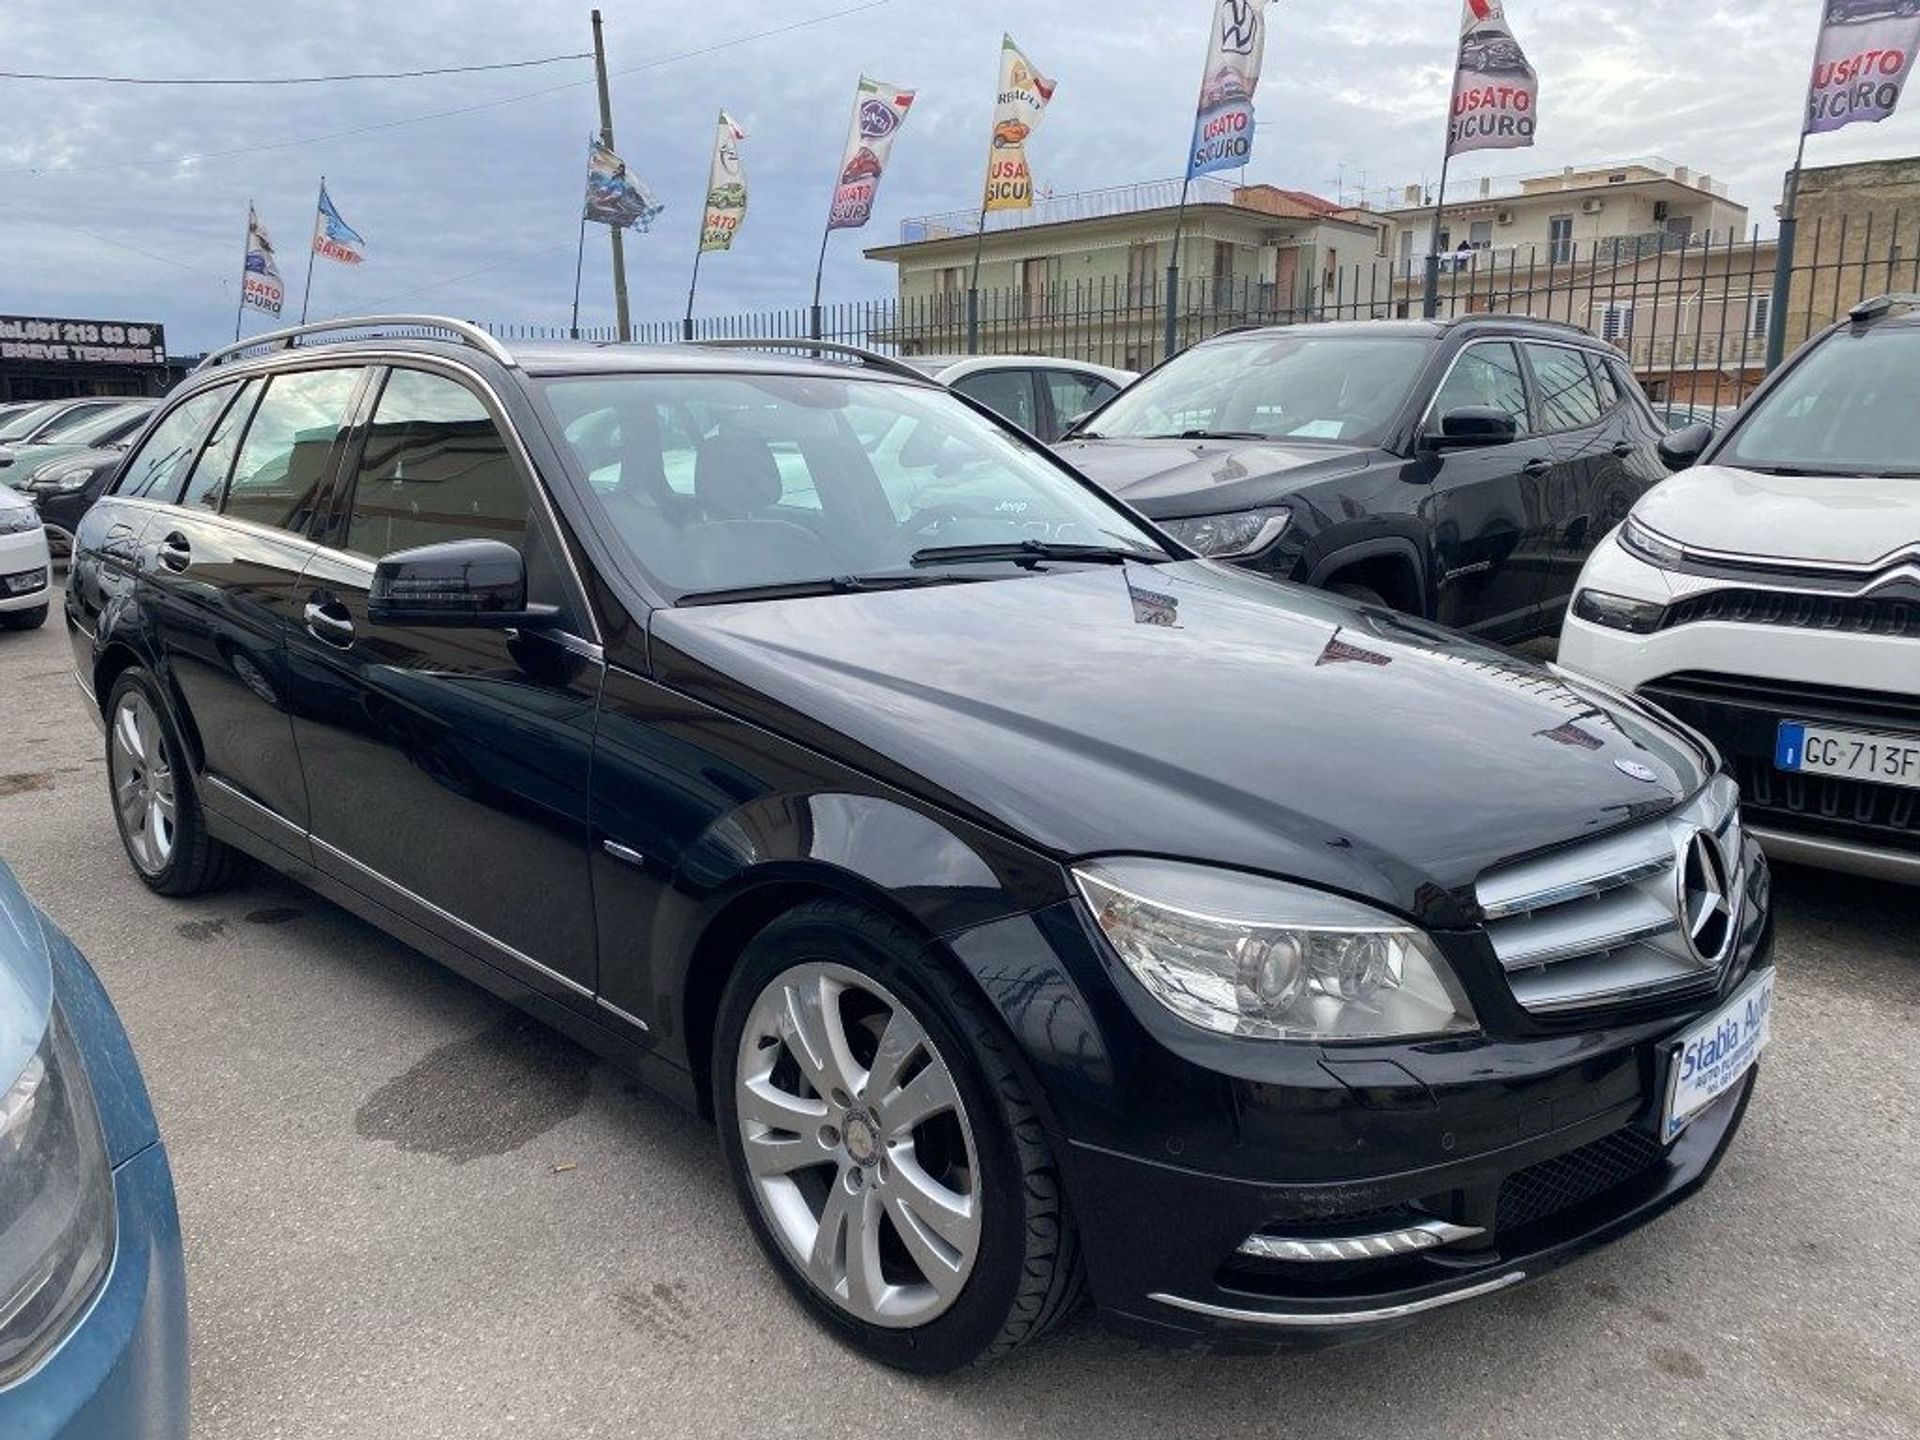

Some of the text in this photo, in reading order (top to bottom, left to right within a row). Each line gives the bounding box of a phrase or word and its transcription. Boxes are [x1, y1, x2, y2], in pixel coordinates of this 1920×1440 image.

[1813, 49, 1905, 90] USATO
[1453, 86, 1530, 117] USATO
[1203, 112, 1248, 142] USATO
[1194, 136, 1248, 168] SICURO
[1681, 1018, 1739, 1083] Stabia
